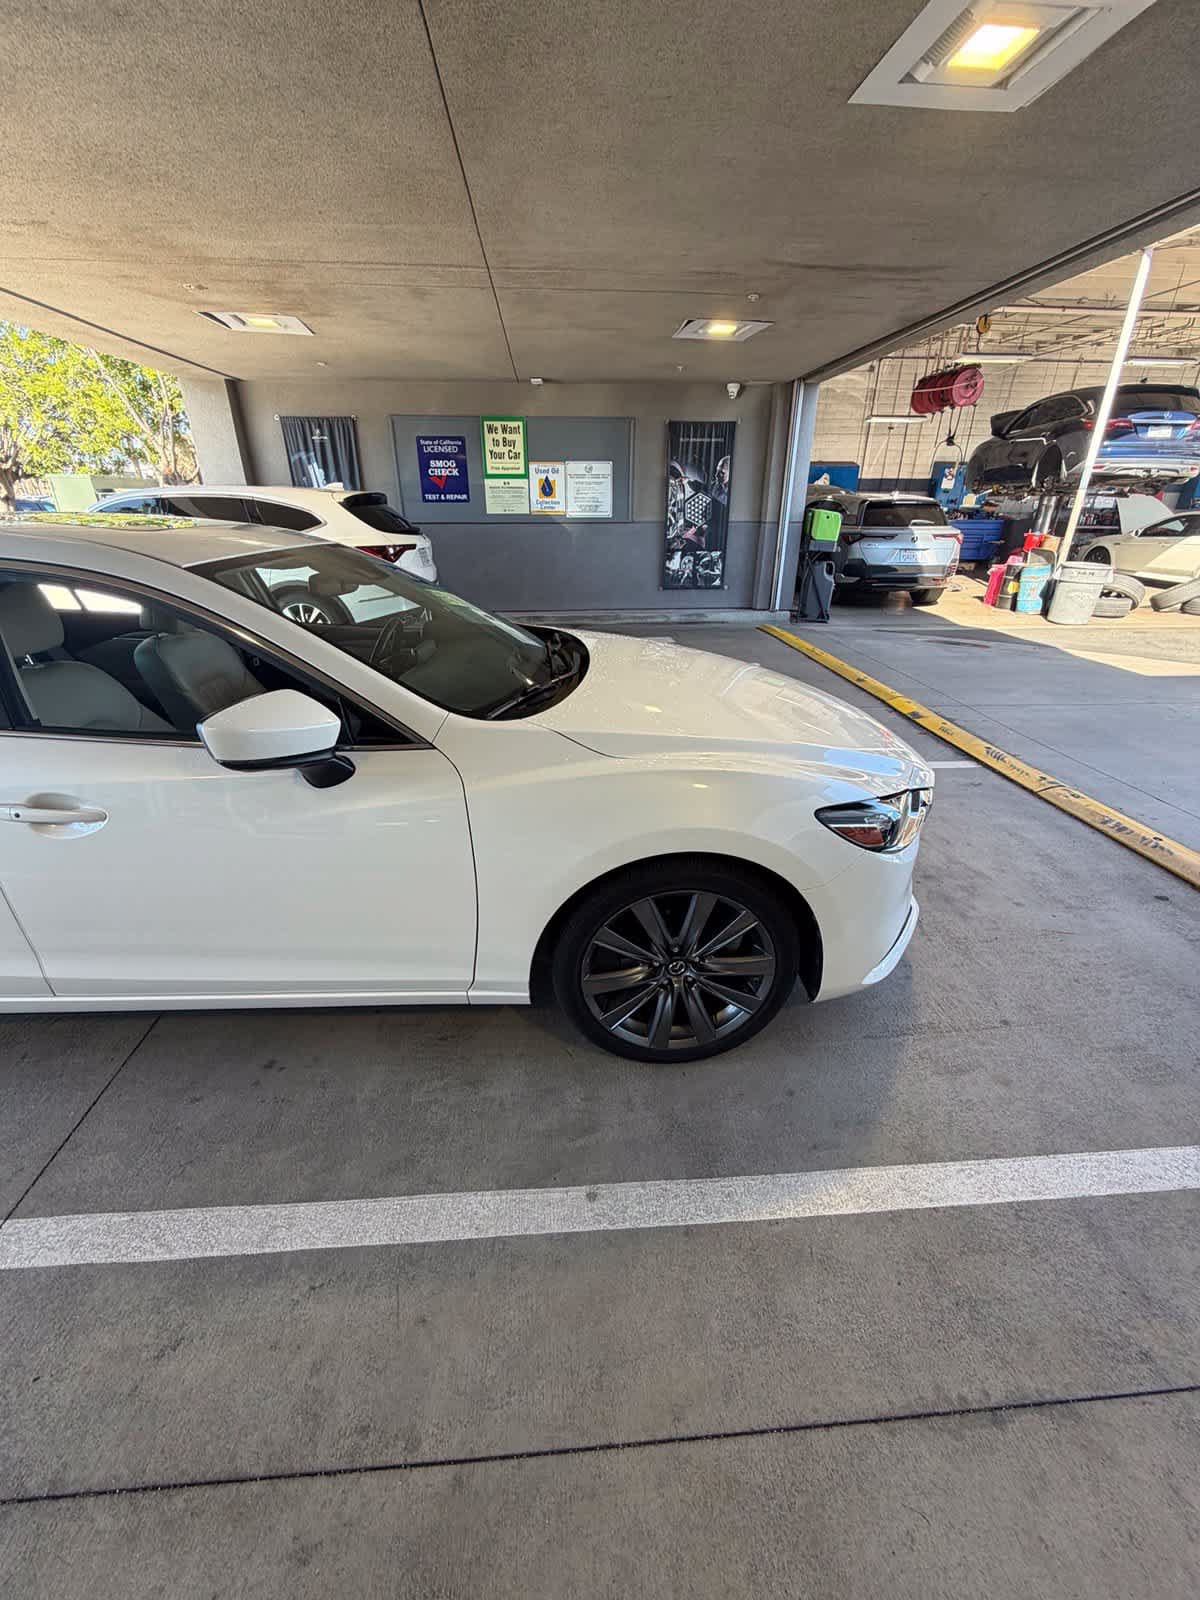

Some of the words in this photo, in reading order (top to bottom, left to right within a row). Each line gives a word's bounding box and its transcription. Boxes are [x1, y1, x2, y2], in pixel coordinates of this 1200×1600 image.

[486, 423, 499, 435] We
[500, 423, 521, 435] Want
[492, 438, 500, 447] to
[502, 436, 517, 449] Buy
[489, 448, 505, 460] Your
[507, 449, 521, 460] Car
[429, 459, 456, 468] SMOG
[427, 468, 460, 476] CHECK
